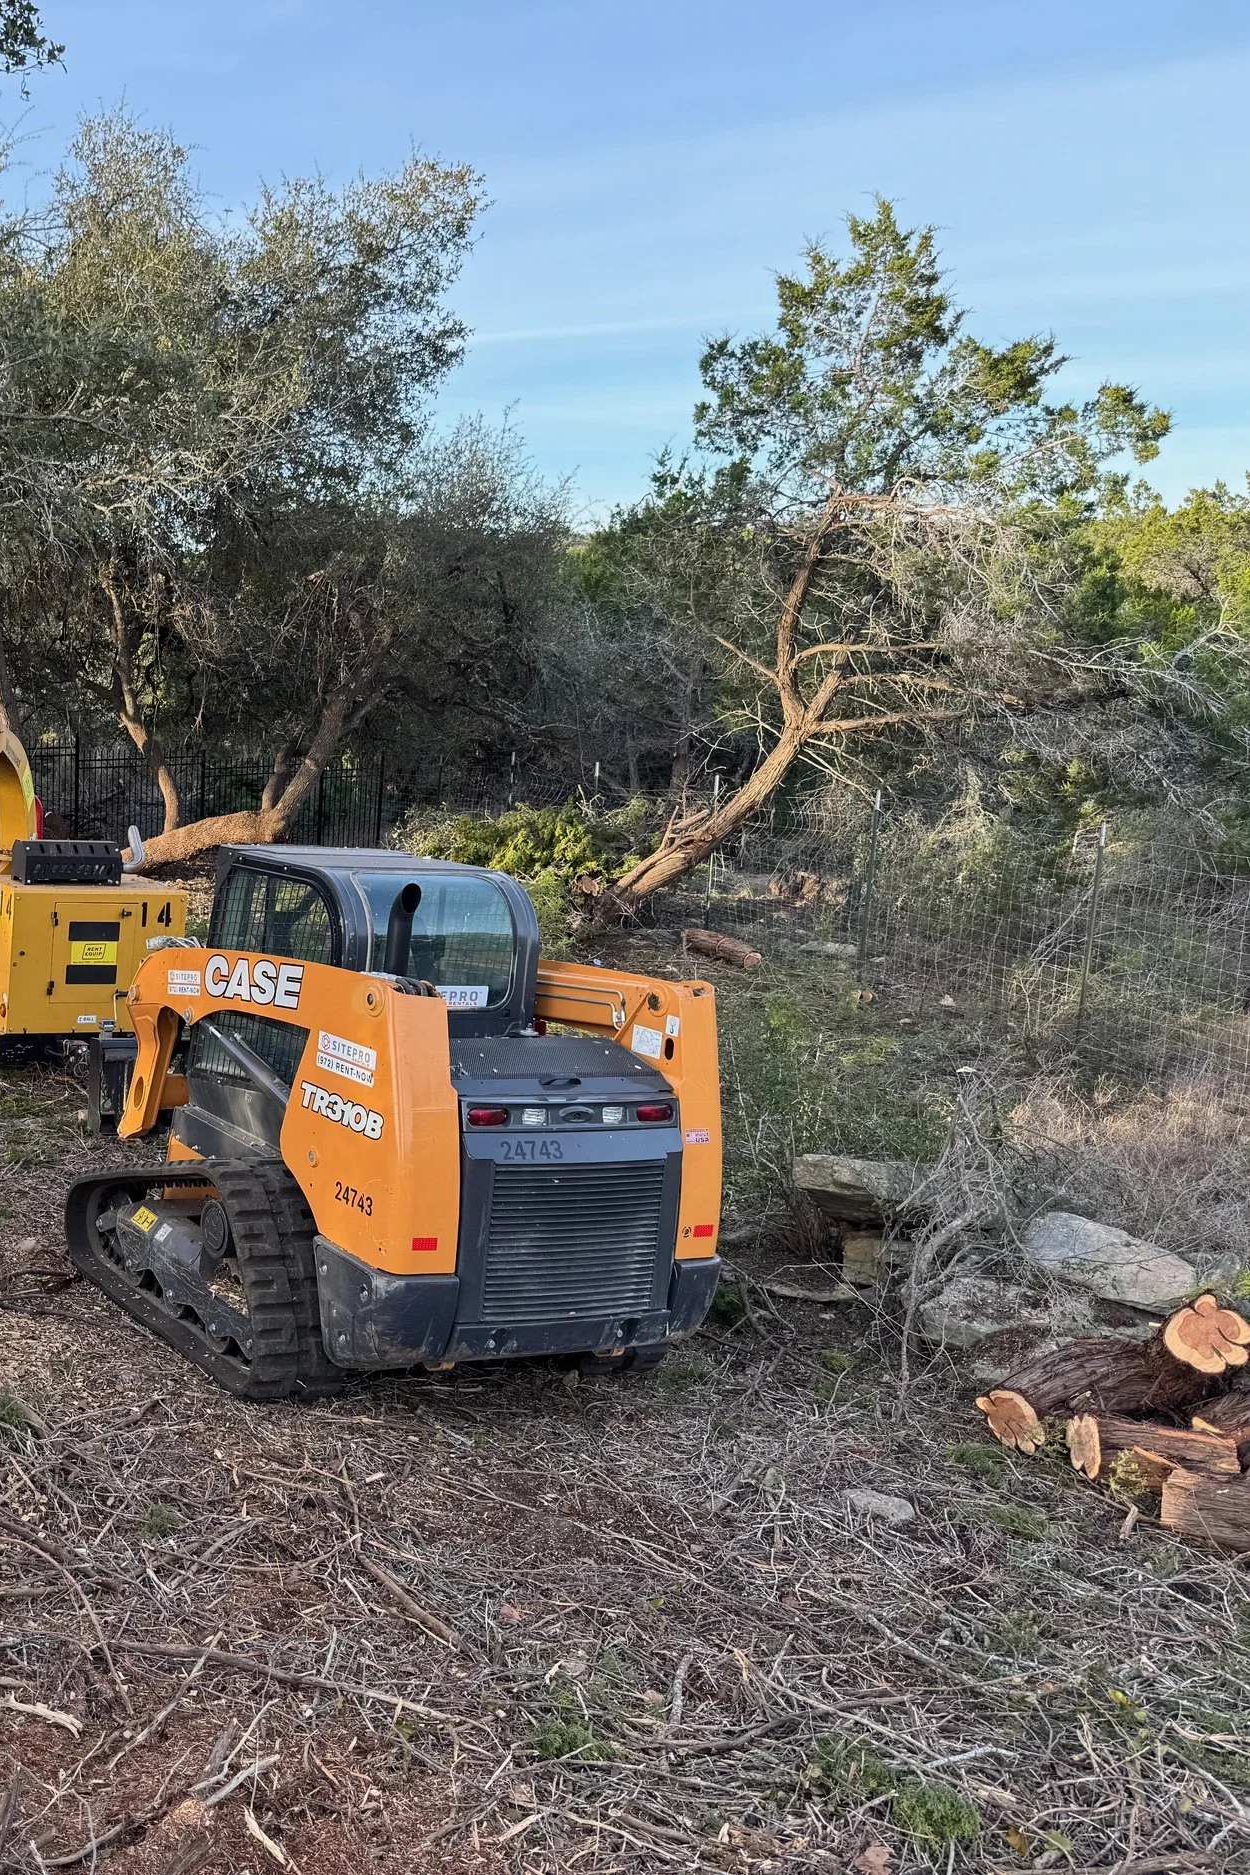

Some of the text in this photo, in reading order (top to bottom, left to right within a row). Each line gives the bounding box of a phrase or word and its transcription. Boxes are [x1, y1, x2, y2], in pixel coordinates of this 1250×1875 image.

[175, 973, 198, 981] SITEPRO
[204, 954, 305, 1010] CASE
[332, 1040, 371, 1064] SITEPRO
[317, 1053, 374, 1084] (972) RENT-NOW
[301, 1080, 385, 1140] TR310B
[500, 1140, 564, 1161] 24743
[335, 1180, 373, 1217] 24743
